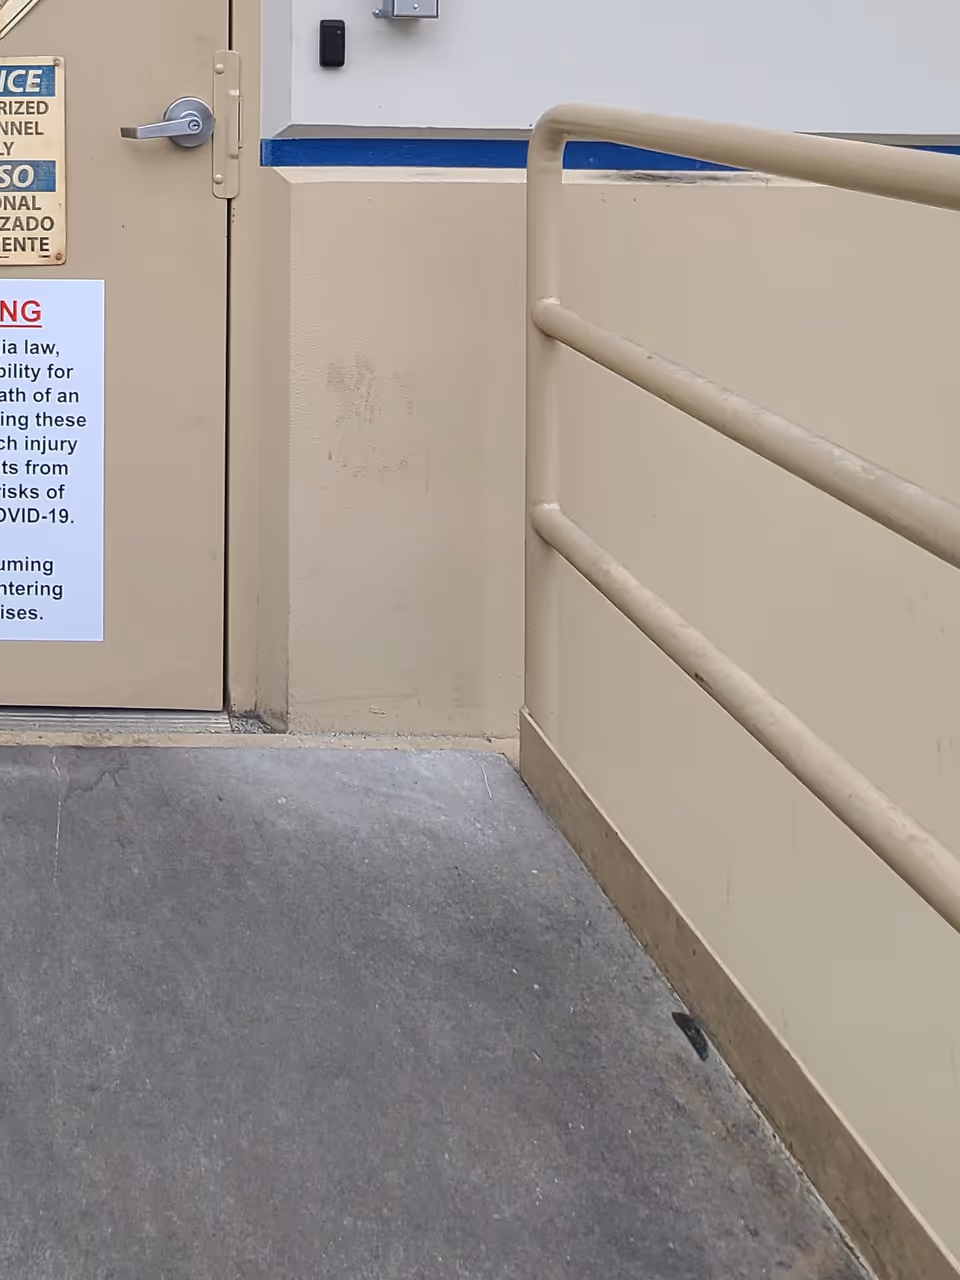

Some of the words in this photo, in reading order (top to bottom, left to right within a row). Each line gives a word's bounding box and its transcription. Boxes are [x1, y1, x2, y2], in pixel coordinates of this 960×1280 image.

[24, 339, 60, 358] law,
[46, 363, 74, 379] for
[32, 387, 52, 403] of
[57, 391, 79, 403] an
[35, 411, 87, 428] these
[24, 435, 78, 456] injury
[24, 459, 69, 476] from
[46, 483, 66, 500] of
